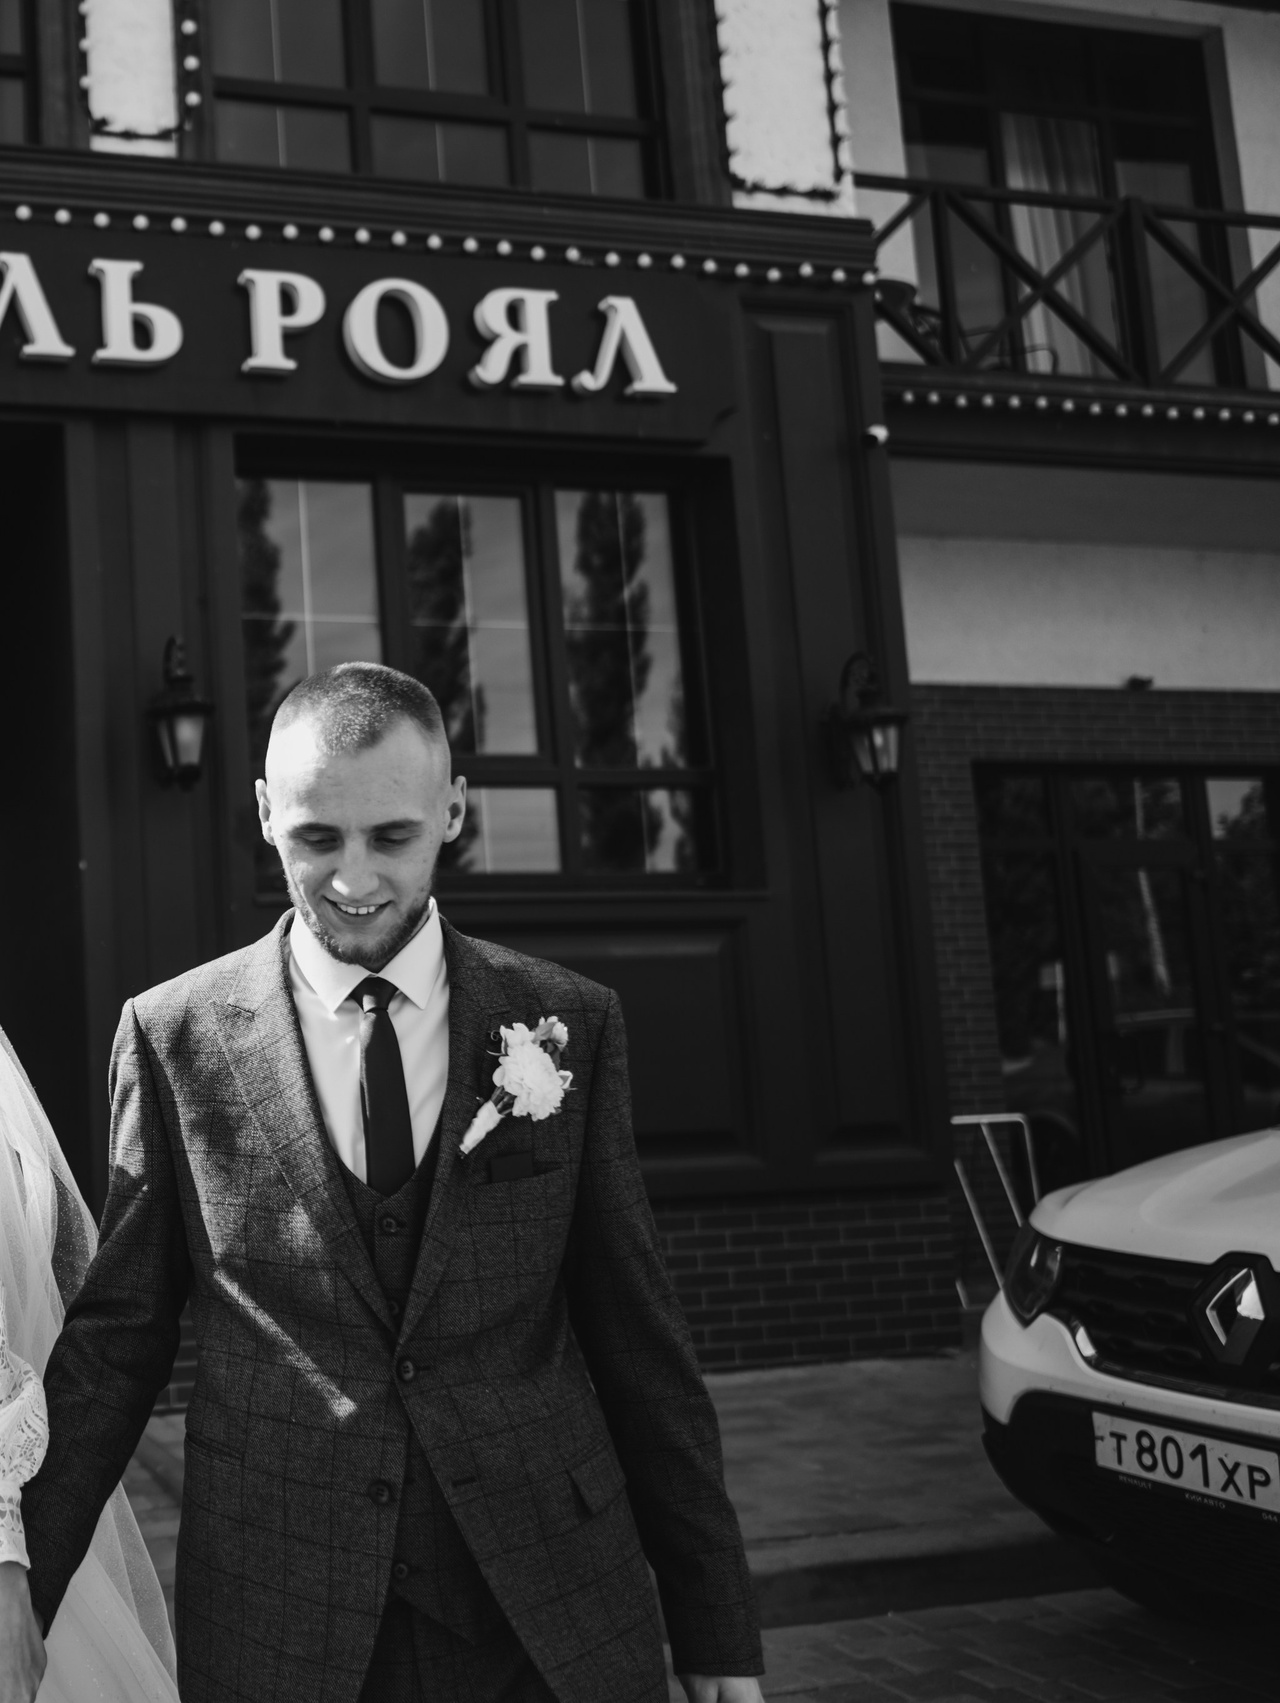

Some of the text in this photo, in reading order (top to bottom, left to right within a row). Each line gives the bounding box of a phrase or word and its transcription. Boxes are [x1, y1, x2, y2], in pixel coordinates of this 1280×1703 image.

[236, 267, 678, 395] РОЯЛ
[1109, 1429, 1271, 1500] Т801ХР
[1118, 1475, 1152, 1489] RENAULT
